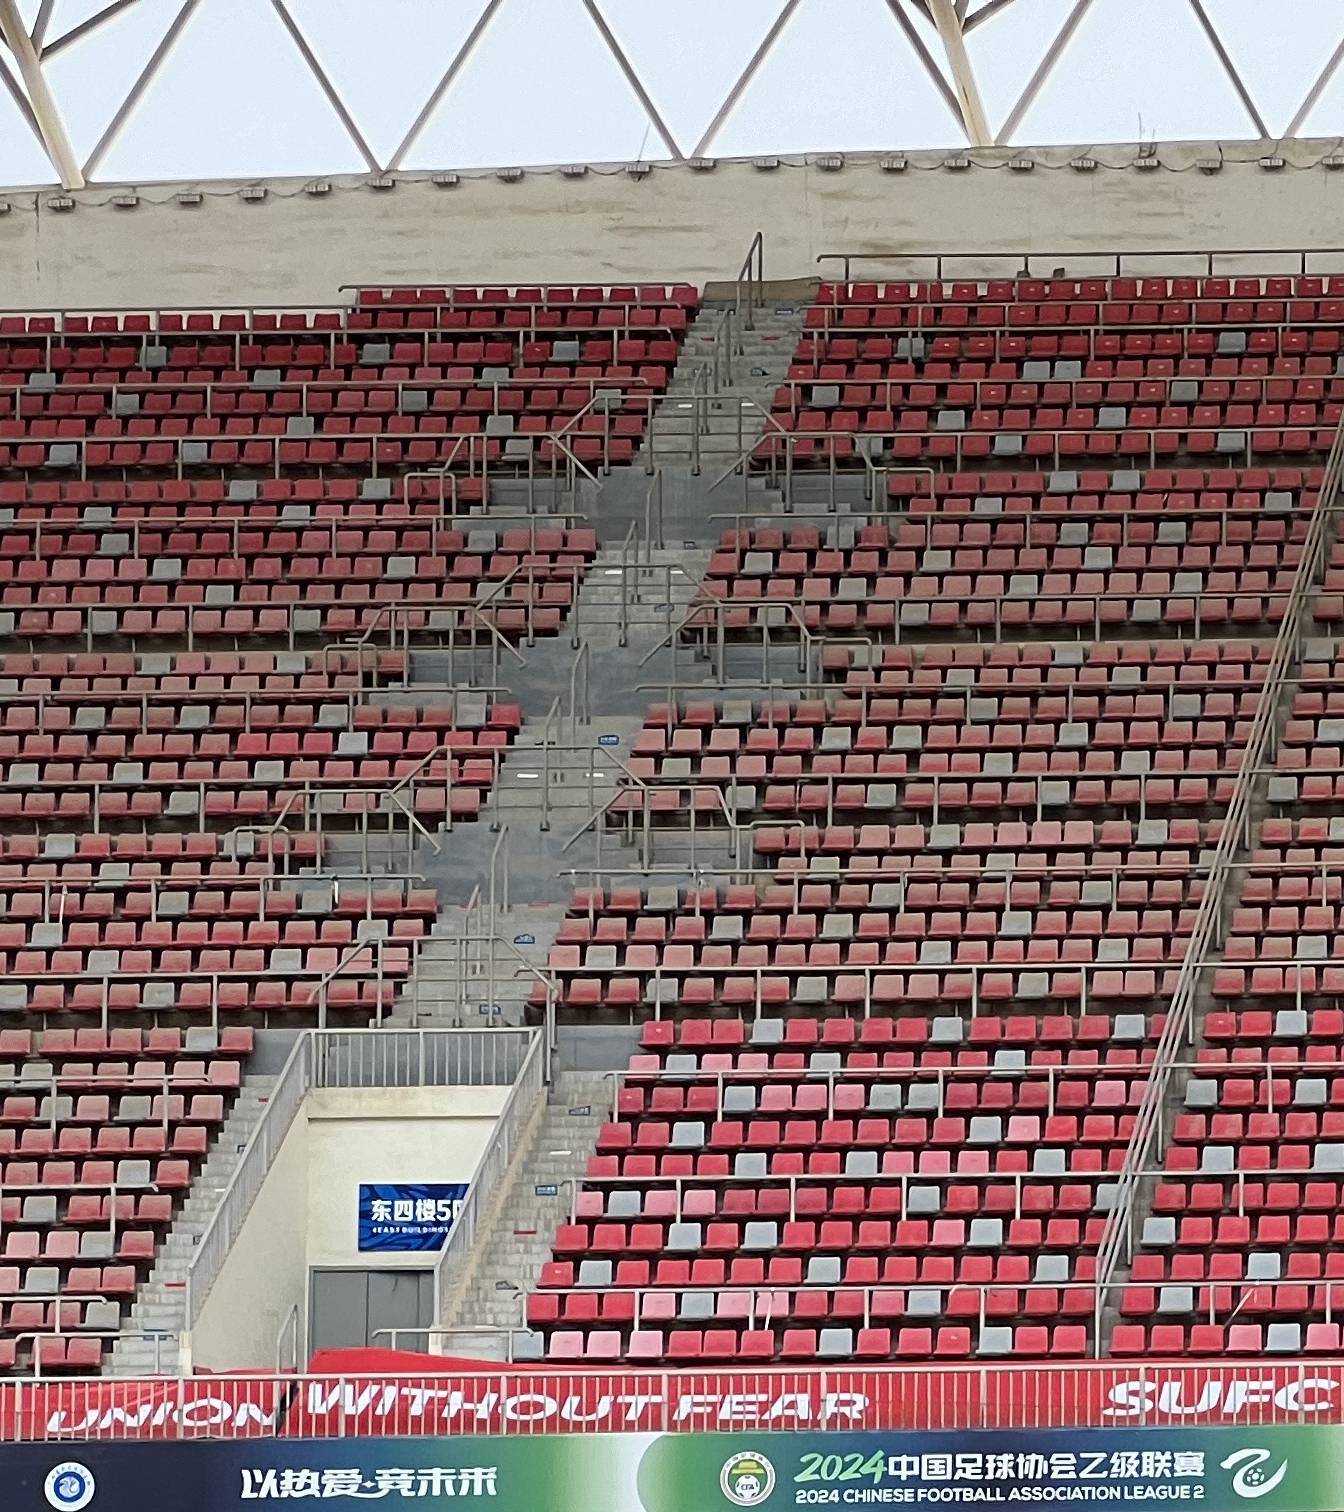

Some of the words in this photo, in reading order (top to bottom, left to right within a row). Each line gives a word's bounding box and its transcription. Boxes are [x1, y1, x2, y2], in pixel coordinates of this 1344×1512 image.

[47, 1398, 276, 1433] UNION
[307, 1381, 663, 1420] WITHOUT
[671, 1391, 869, 1420] FEAR
[1102, 1378, 1340, 1416] SUFC
[794, 1450, 1206, 1484] 2024中国足球协会乙级联赛
[796, 1488, 840, 1504] 2024
[843, 1487, 914, 1503] CHINESE
[917, 1486, 1005, 1503] FOOTBALL
[1007, 1485, 1122, 1501] ASSOCIATION
[1124, 1485, 1191, 1500] LEAGUE
[1193, 1484, 1204, 1499] 2
